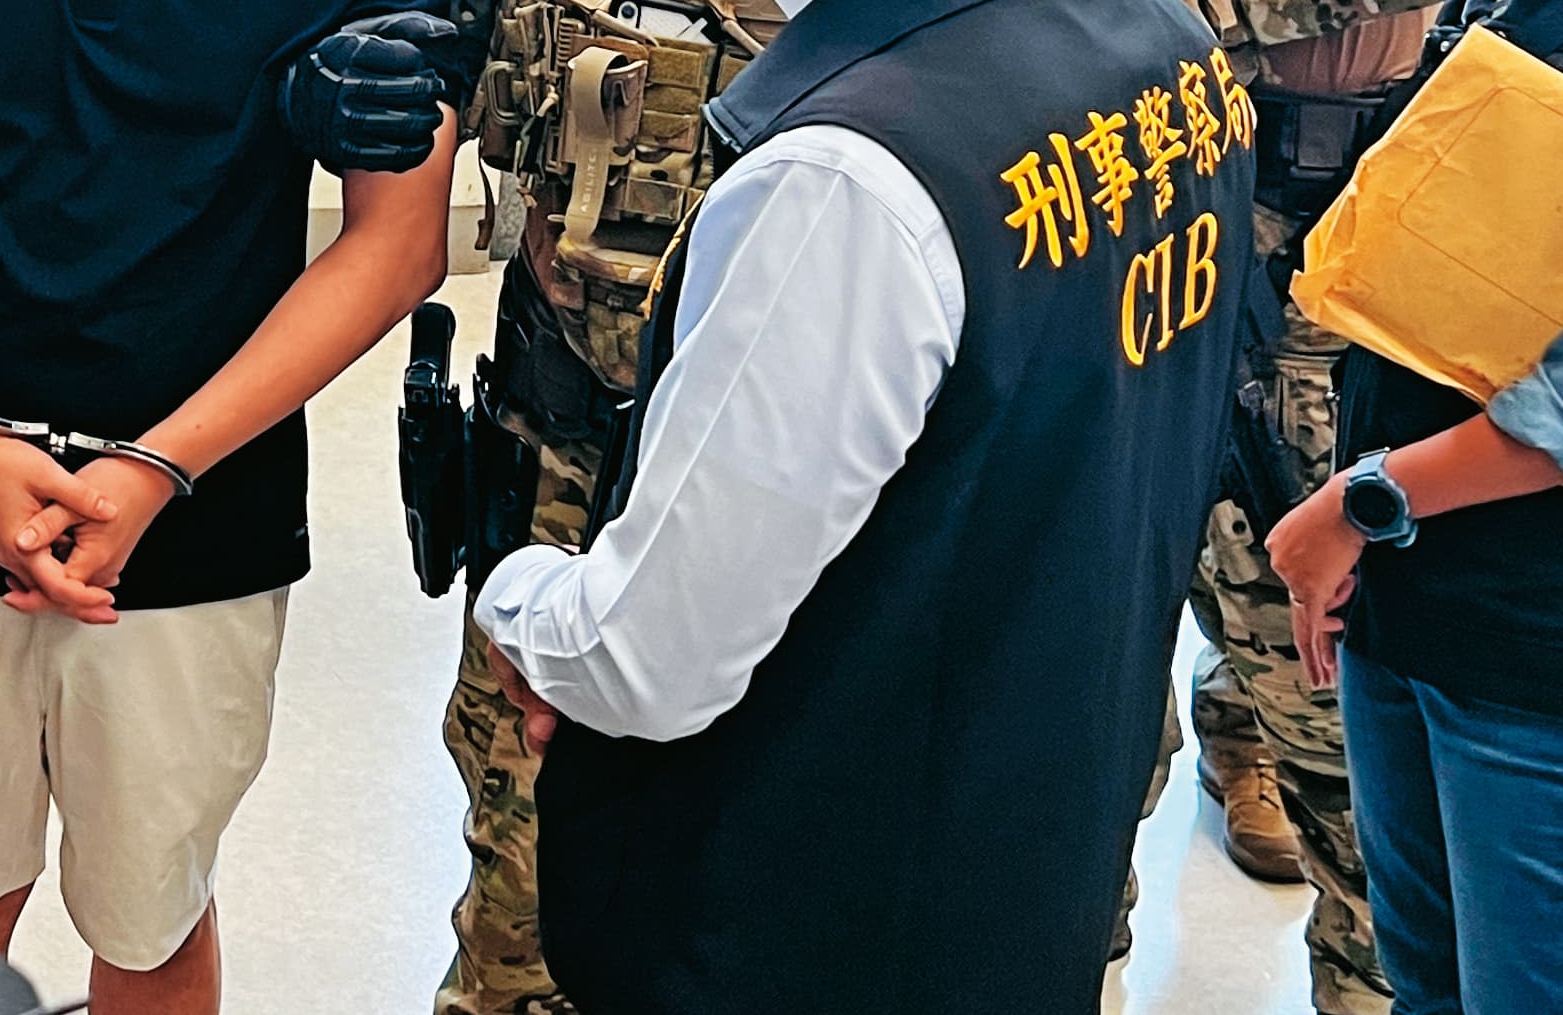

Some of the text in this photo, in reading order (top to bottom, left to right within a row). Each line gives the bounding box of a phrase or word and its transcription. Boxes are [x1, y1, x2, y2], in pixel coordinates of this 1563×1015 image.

[999, 46, 1252, 270] 刑事警察局
[1121, 211, 1219, 367] CIB
